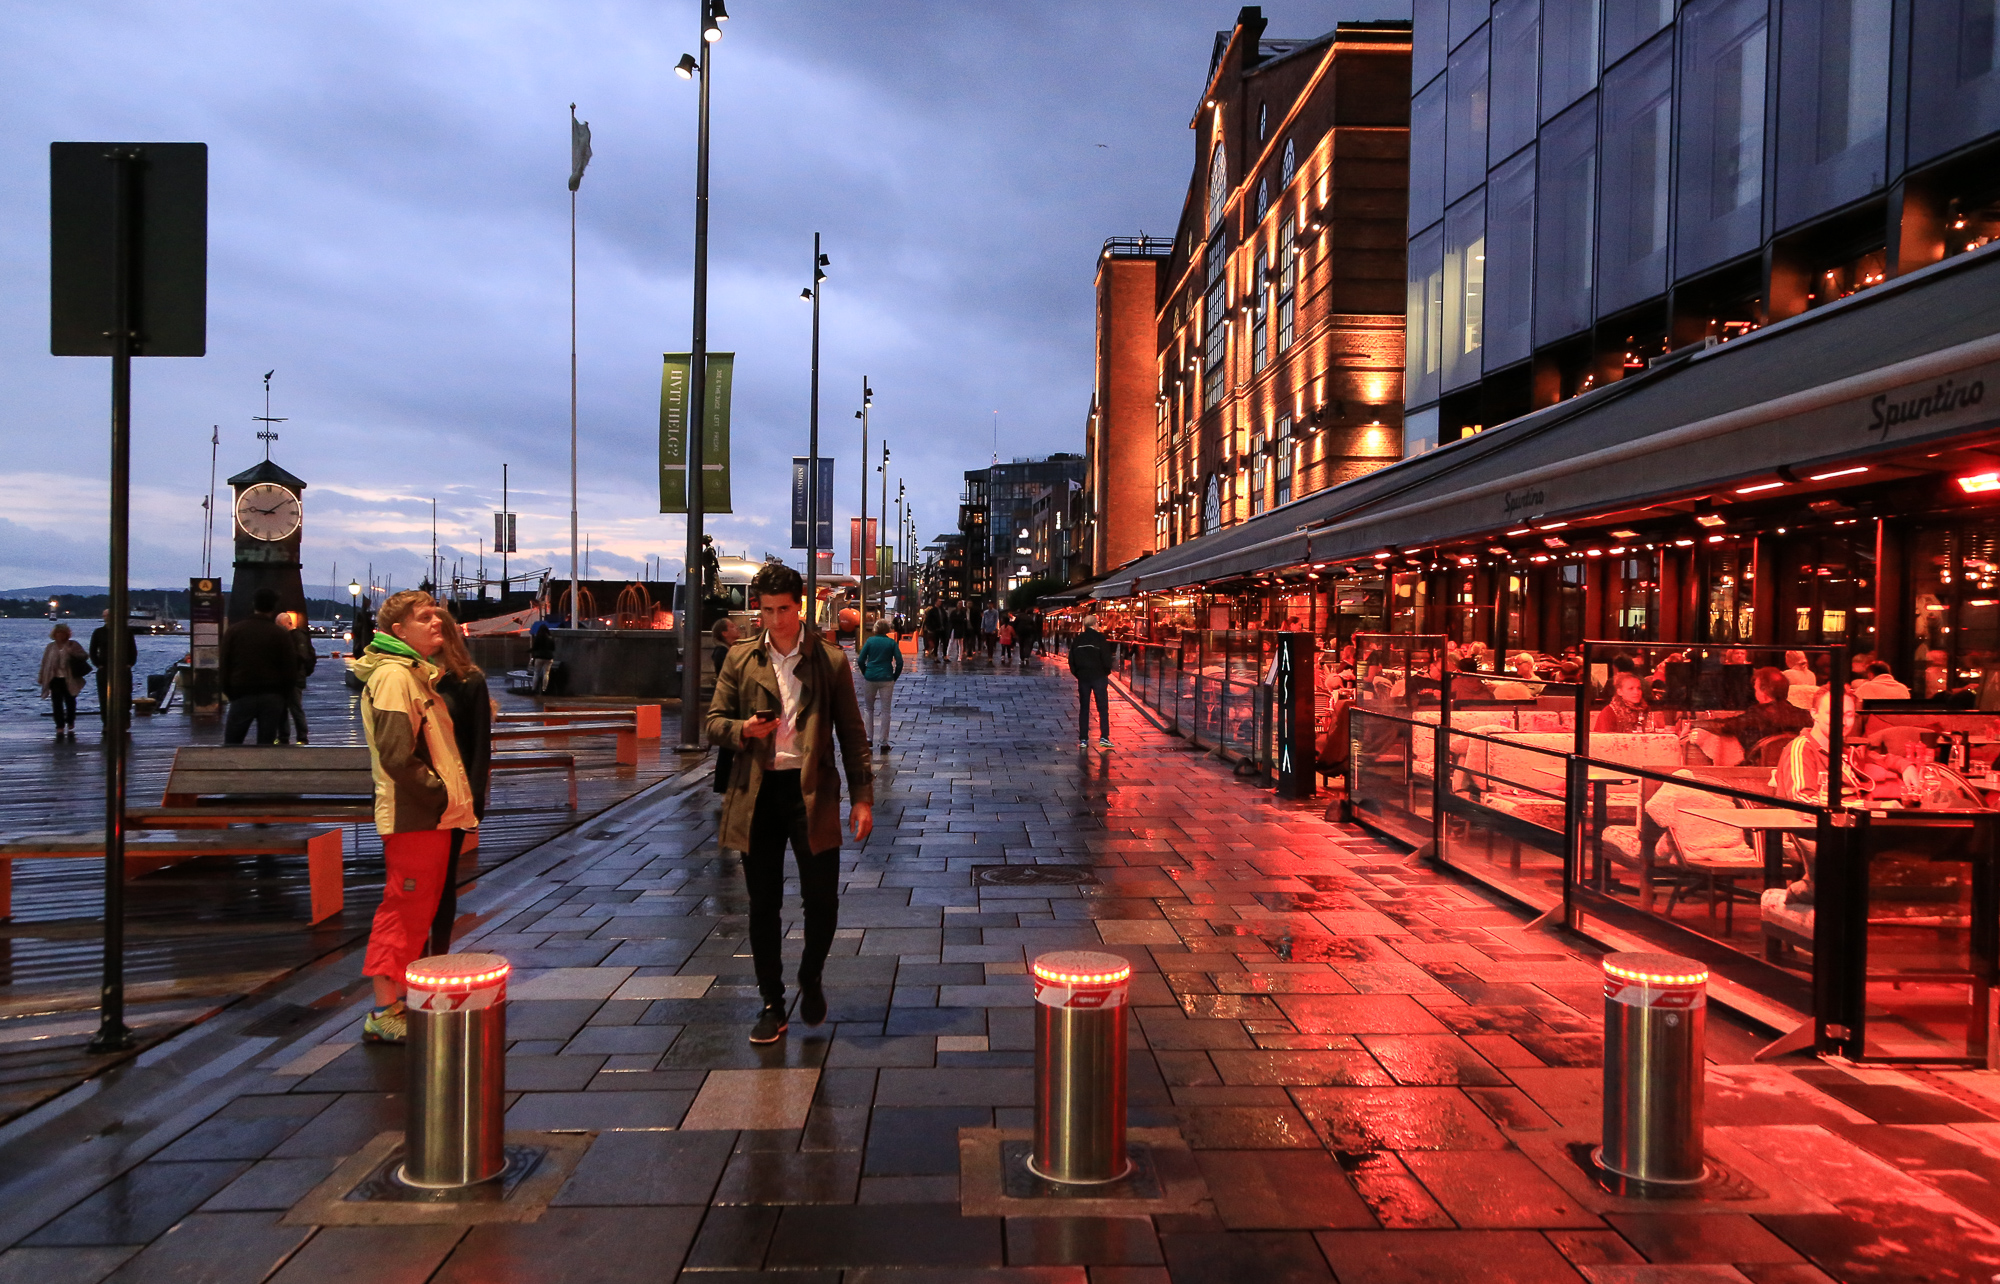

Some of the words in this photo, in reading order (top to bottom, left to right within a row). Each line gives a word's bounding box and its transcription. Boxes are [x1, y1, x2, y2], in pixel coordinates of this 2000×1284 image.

[669, 369, 683, 405] HVIT
[1868, 379, 1985, 441] Spuntino
[667, 407, 681, 457] HELG?
[1504, 487, 1545, 519] Spuntino
[1281, 640, 1292, 774] ASIA
